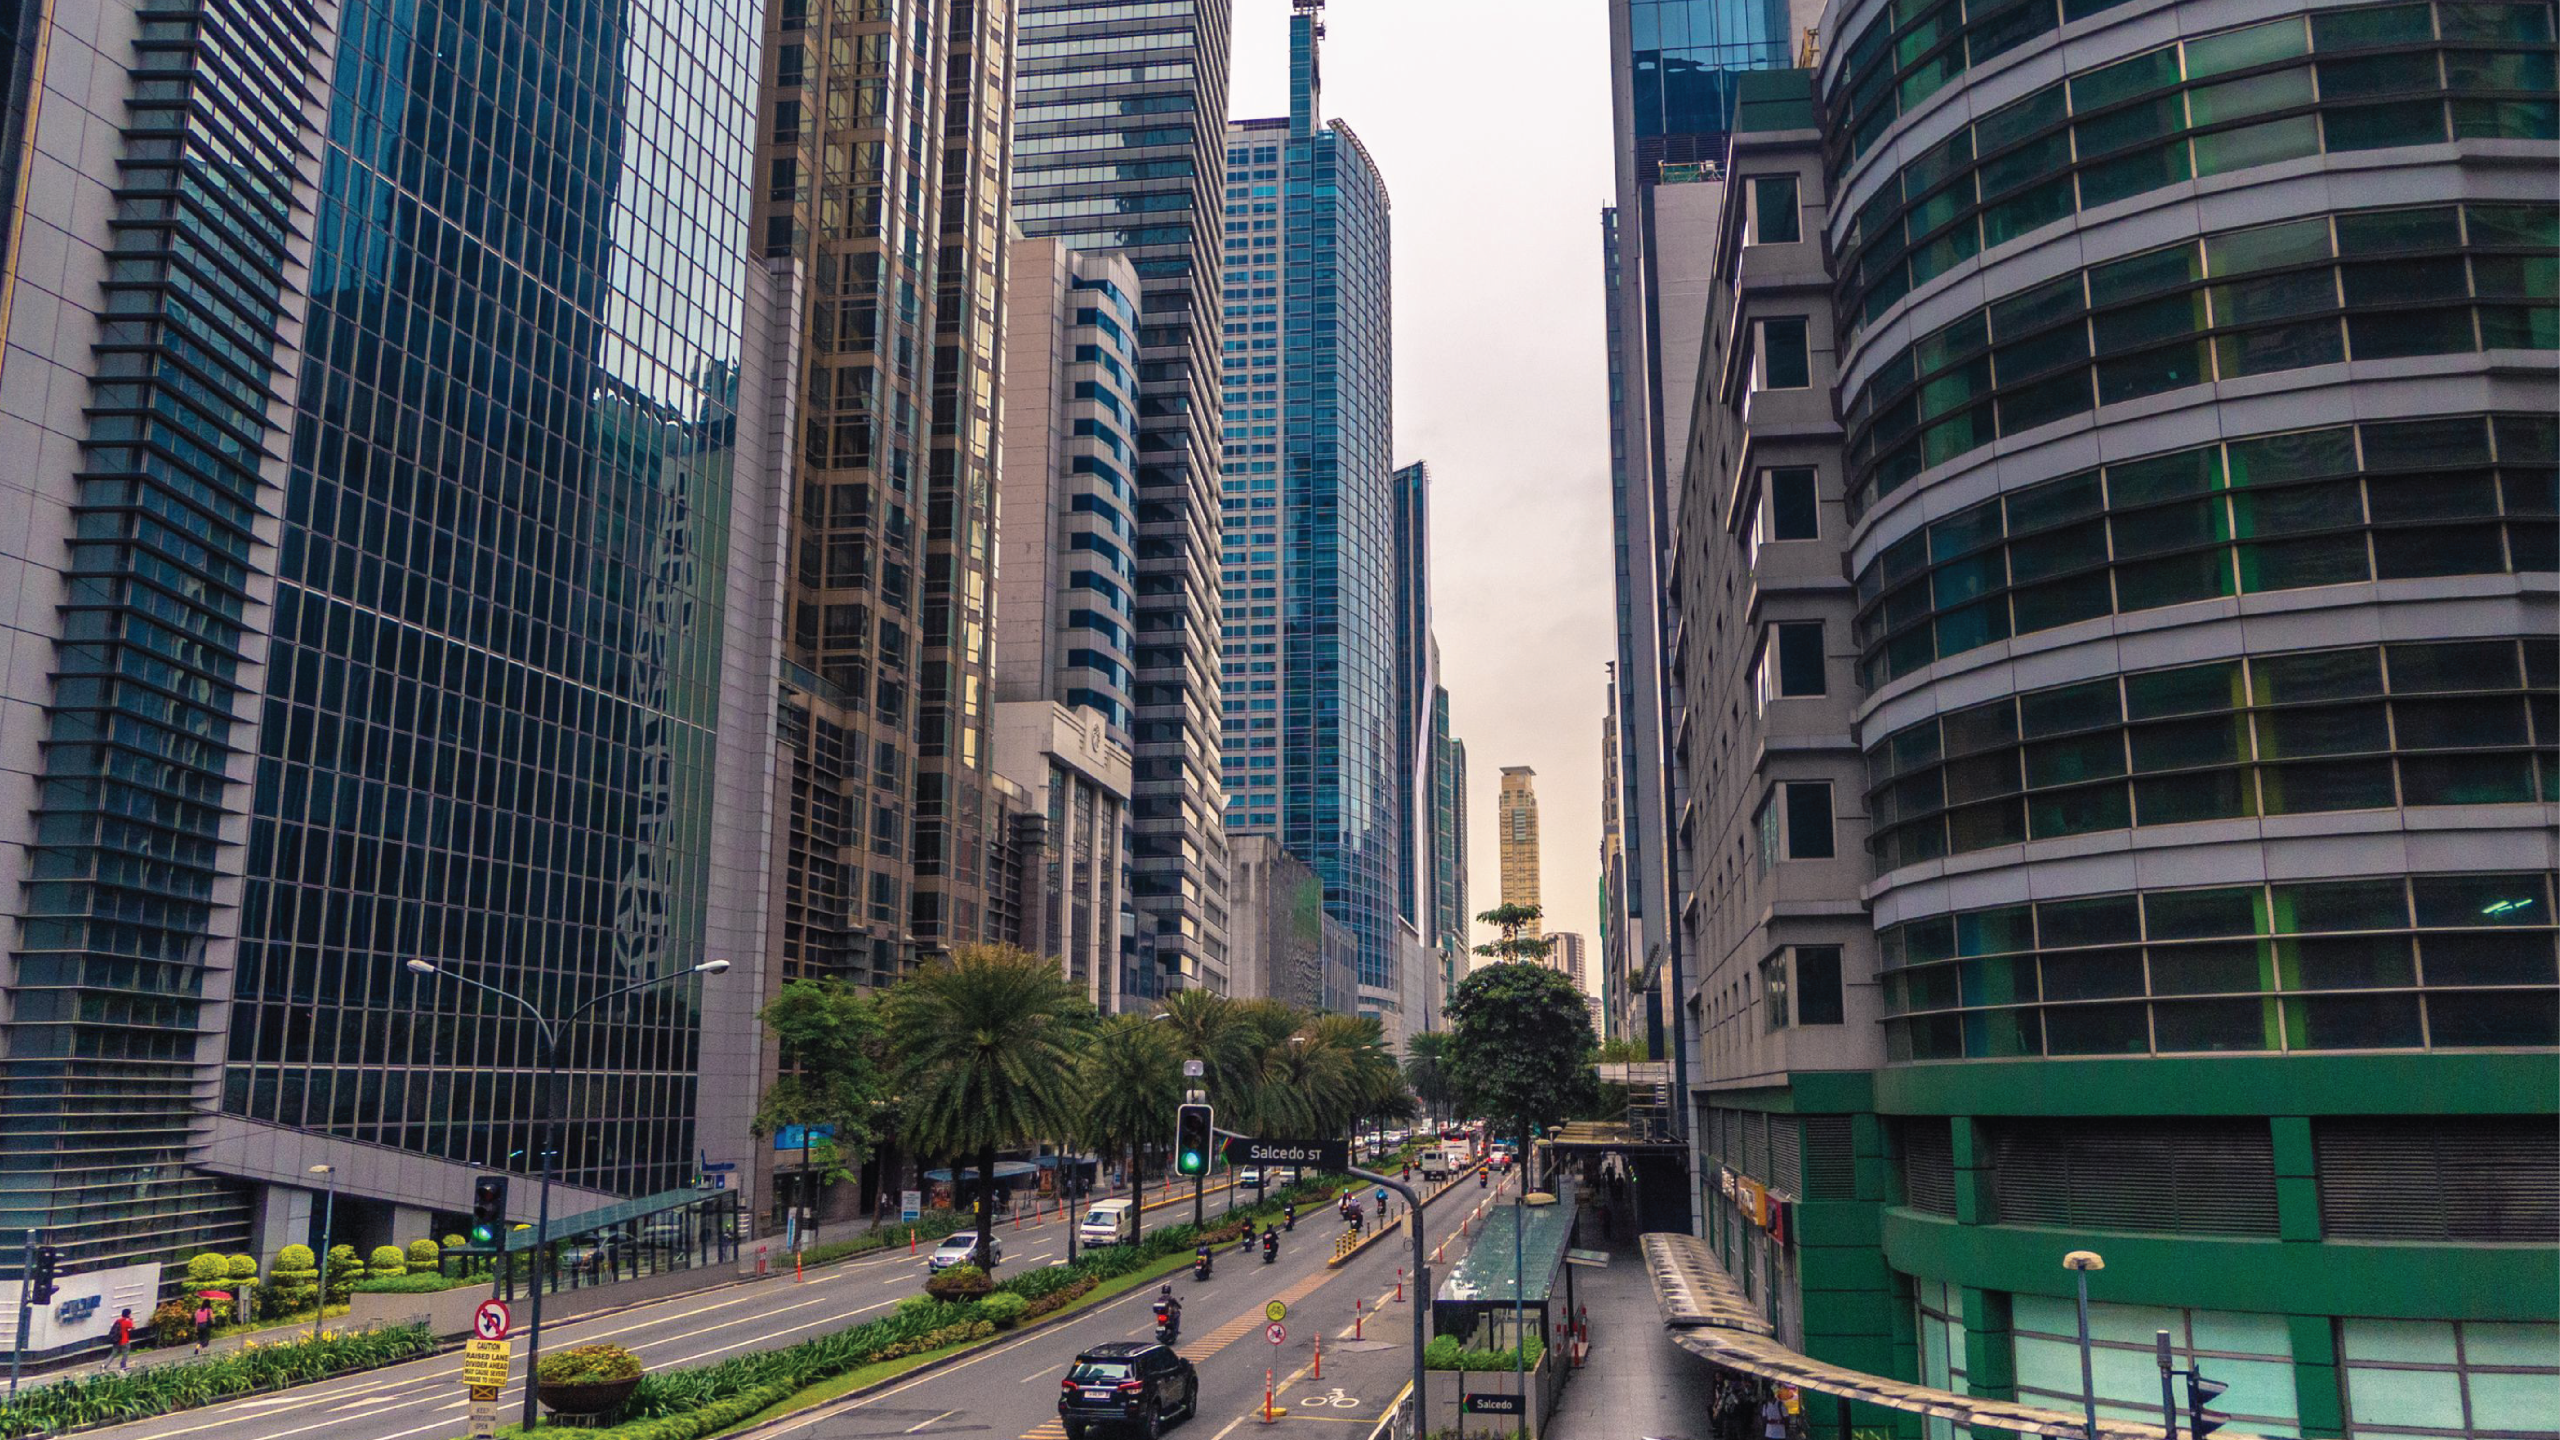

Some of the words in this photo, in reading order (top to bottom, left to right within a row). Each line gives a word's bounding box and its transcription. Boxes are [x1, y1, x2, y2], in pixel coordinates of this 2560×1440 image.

[1250, 1145, 1305, 1160] Salcedo
[1308, 1149, 1322, 1160] ST
[477, 1341, 501, 1351] CAUTION
[466, 1352, 490, 1360] RAISED
[491, 1353, 509, 1362] LANE
[465, 1360, 488, 1368] DIVIDER
[489, 1361, 508, 1370] AHEAD
[1477, 1399, 1512, 1409] Salcedo
